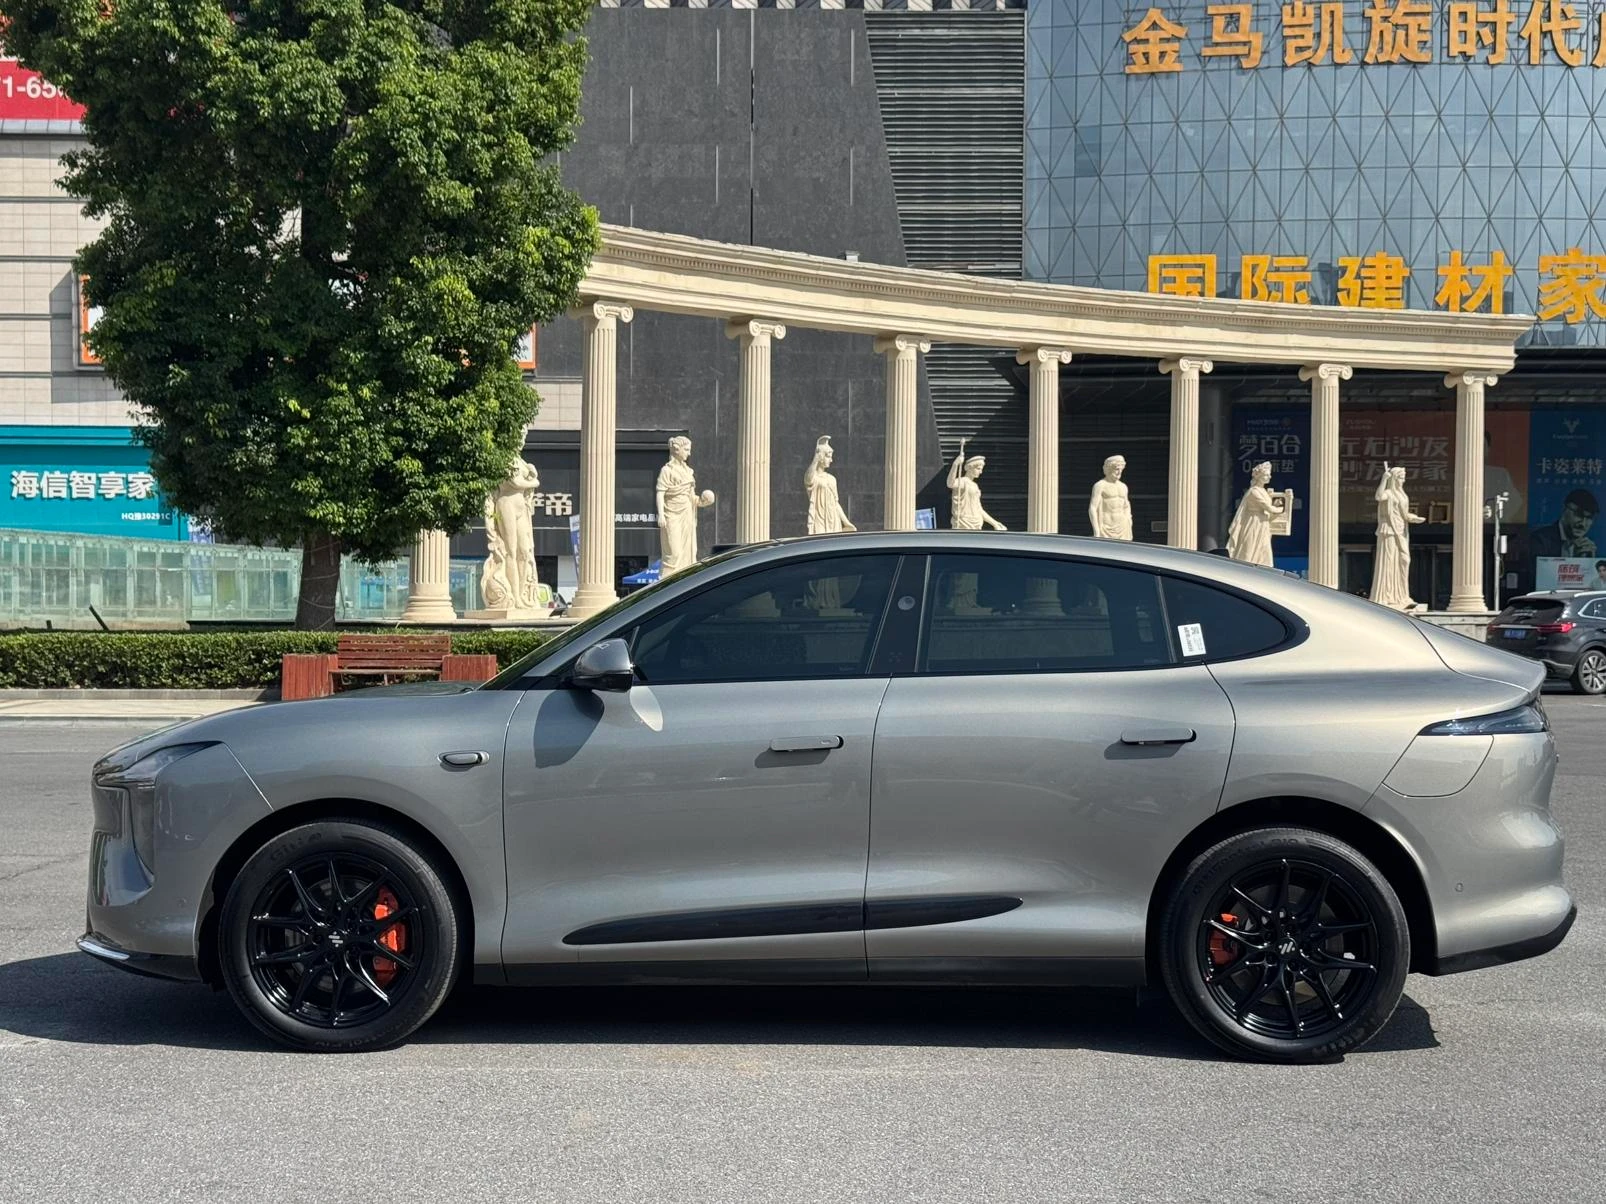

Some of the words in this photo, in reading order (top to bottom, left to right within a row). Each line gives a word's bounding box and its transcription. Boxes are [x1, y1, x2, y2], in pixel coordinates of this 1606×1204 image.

[1121, 0, 1606, 75] 金马凯旋时代
[11, 471, 154, 499] 海信智享家
